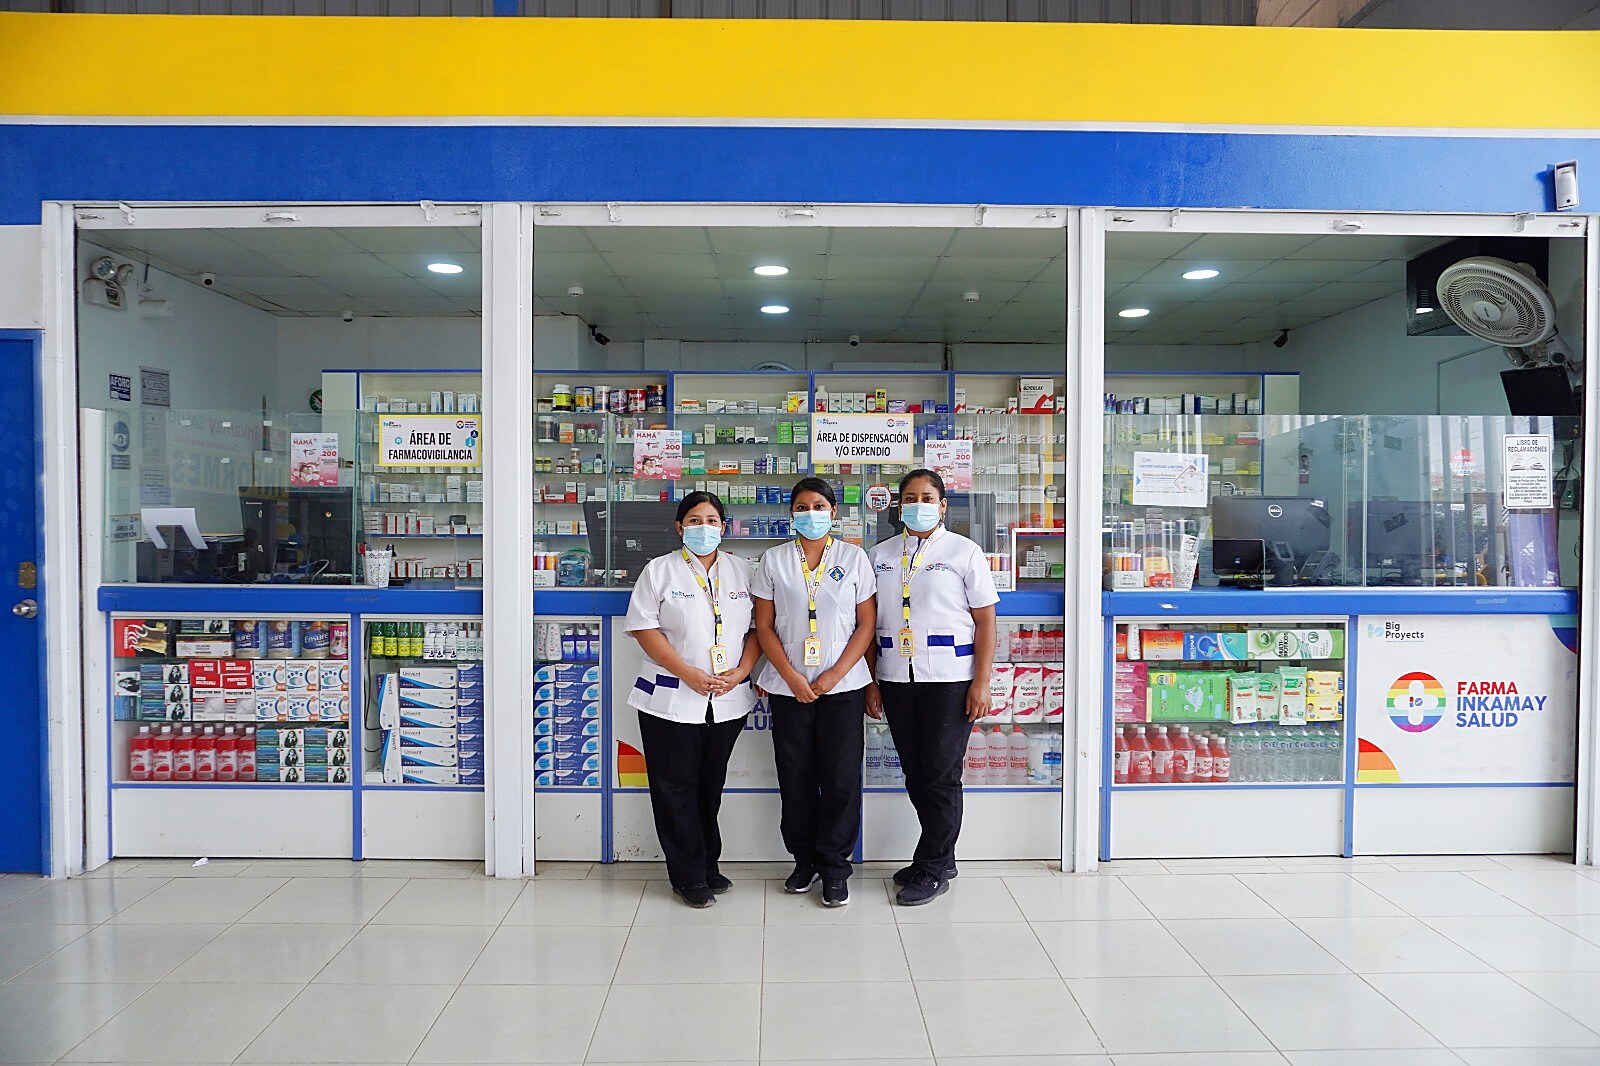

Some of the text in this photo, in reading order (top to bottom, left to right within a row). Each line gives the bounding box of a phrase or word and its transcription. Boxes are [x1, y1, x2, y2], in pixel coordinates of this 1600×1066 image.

[410, 430, 452, 445] ÁREA DE
[816, 430, 909, 443] ÁREA DE DISPENSACIÓN
[388, 449, 472, 460] FARMACOVIGILANCIA
[834, 447, 891, 457] Y/O EXPENDIO
[1386, 622, 1400, 631] Big
[304, 633, 328, 642] Ensure
[1386, 631, 1424, 640] Proyects
[1457, 681, 1518, 695] FARMA
[1456, 696, 1547, 711] INKAMAY
[1456, 713, 1518, 727] SALUD
